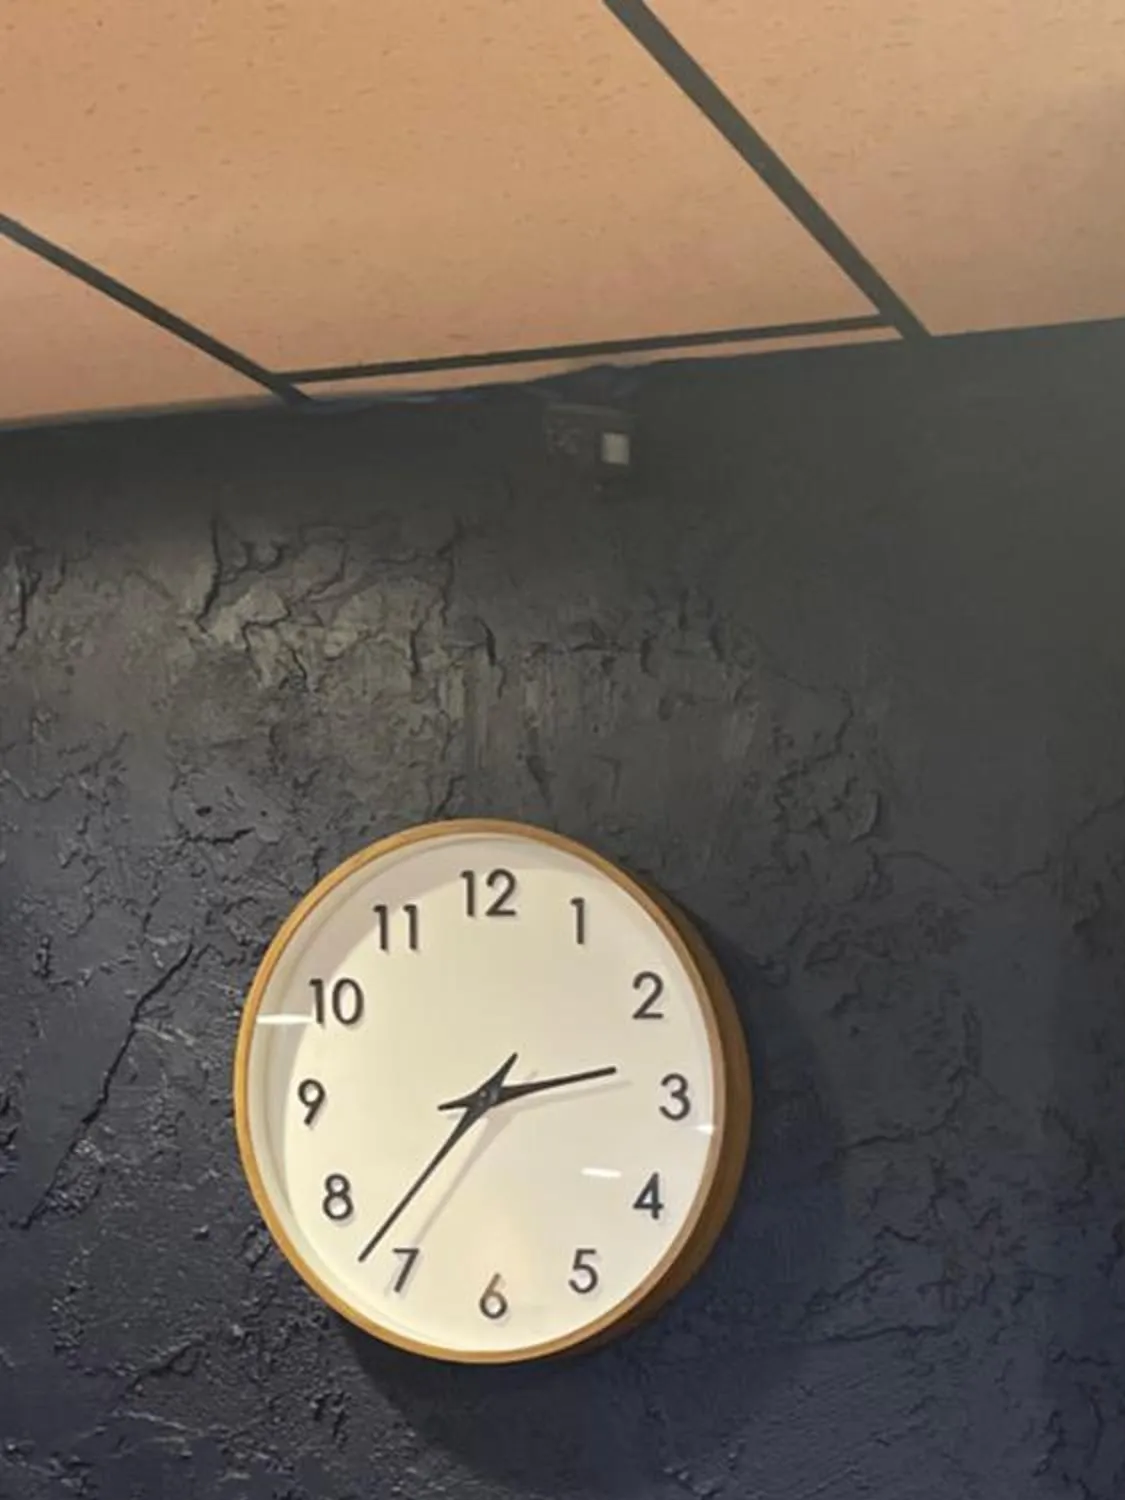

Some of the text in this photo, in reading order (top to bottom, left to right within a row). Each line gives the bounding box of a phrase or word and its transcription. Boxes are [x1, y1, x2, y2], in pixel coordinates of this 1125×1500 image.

[460, 869, 518, 918] 12
[373, 903, 419, 952] 11
[570, 898, 586, 945] 1
[309, 977, 364, 1025] 10
[631, 971, 665, 1020] 2
[297, 1078, 327, 1126] 9
[659, 1073, 692, 1121] 3
[321, 1173, 354, 1221] 8
[632, 1171, 665, 1220] 4
[392, 1247, 420, 1294] 7
[568, 1249, 600, 1295] 5
[478, 1273, 509, 1320] 6
